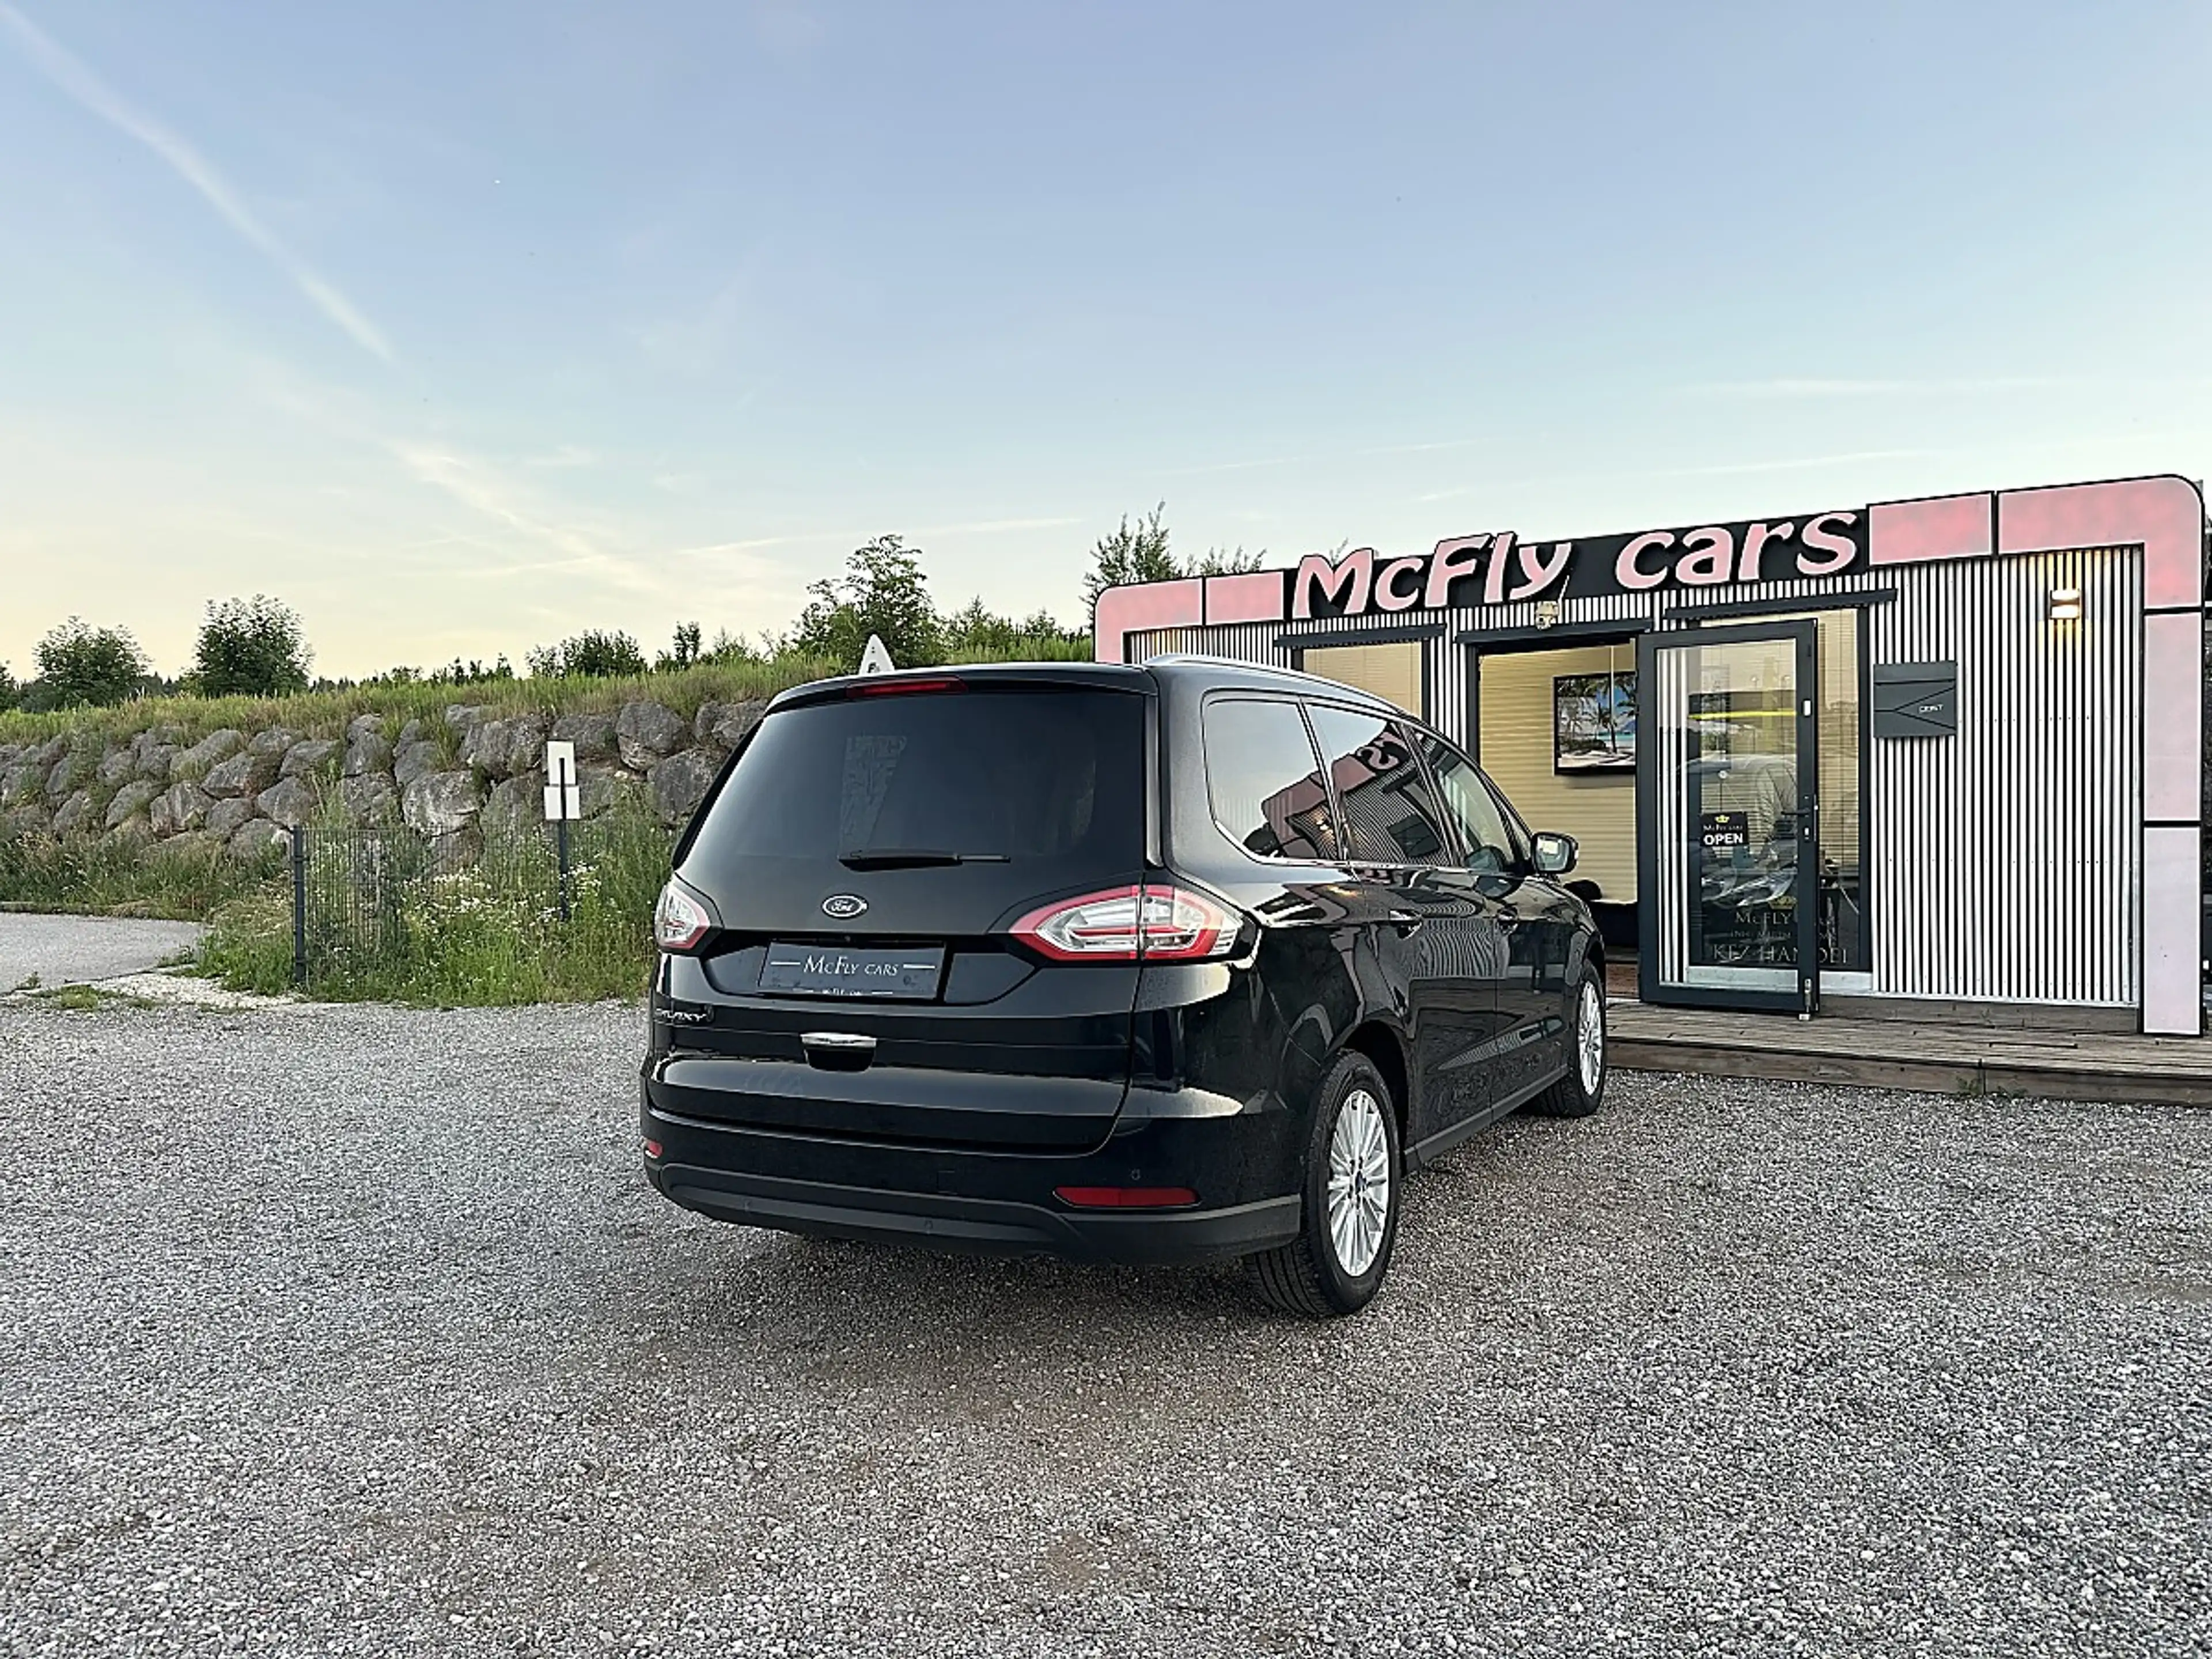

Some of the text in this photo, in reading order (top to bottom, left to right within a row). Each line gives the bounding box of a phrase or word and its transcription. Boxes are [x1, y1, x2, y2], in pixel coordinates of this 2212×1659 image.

[1292, 512, 1858, 619] McFly cars
[1703, 832, 1743, 845] OPEN
